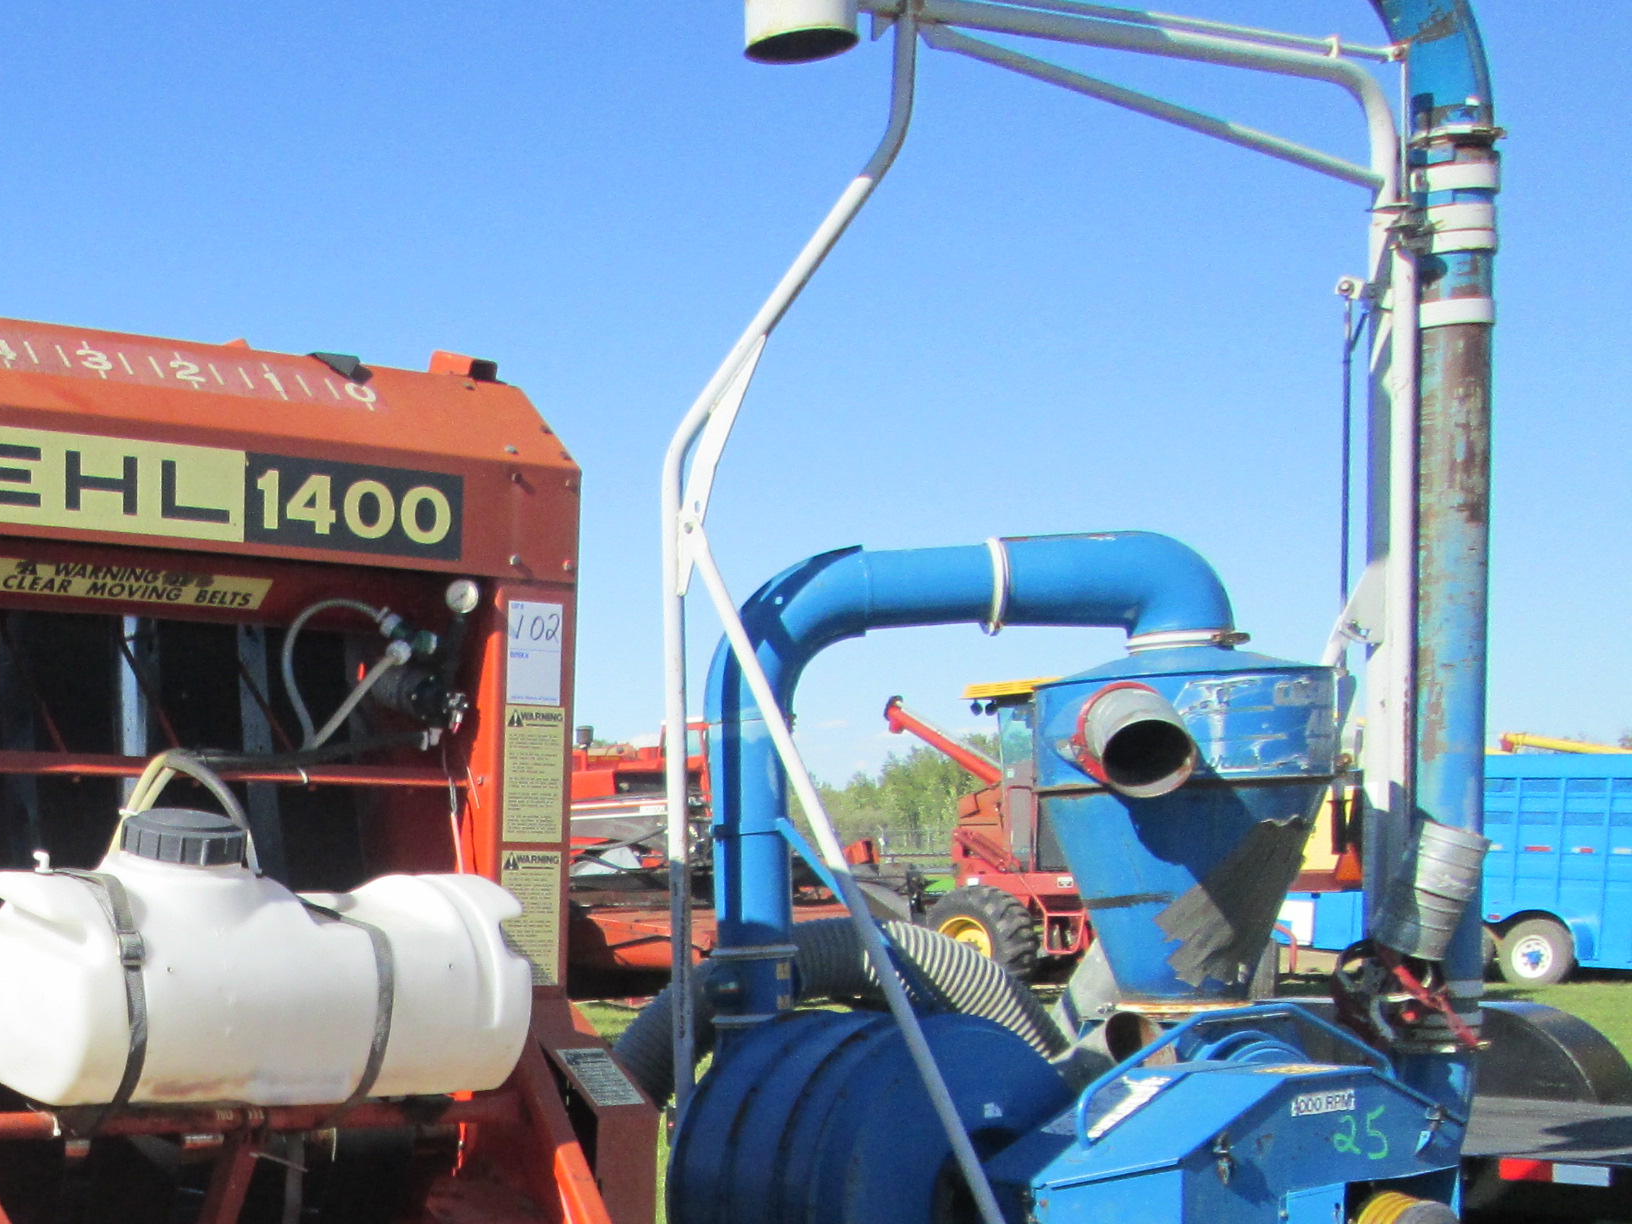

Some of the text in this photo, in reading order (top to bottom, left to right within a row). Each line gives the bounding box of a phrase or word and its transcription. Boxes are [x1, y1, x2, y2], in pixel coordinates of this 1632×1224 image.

[256, 469, 452, 544] 1400
[55, 562, 159, 585] WARNING
[3, 575, 73, 594] CLEAR
[86, 581, 183, 601] MOVING
[195, 588, 253, 607] BELTS
[515, 613, 561, 643] 102
[521, 711, 563, 722] WARNING
[517, 854, 560, 864] WARNING
[1333, 1105, 1389, 1160] 25
